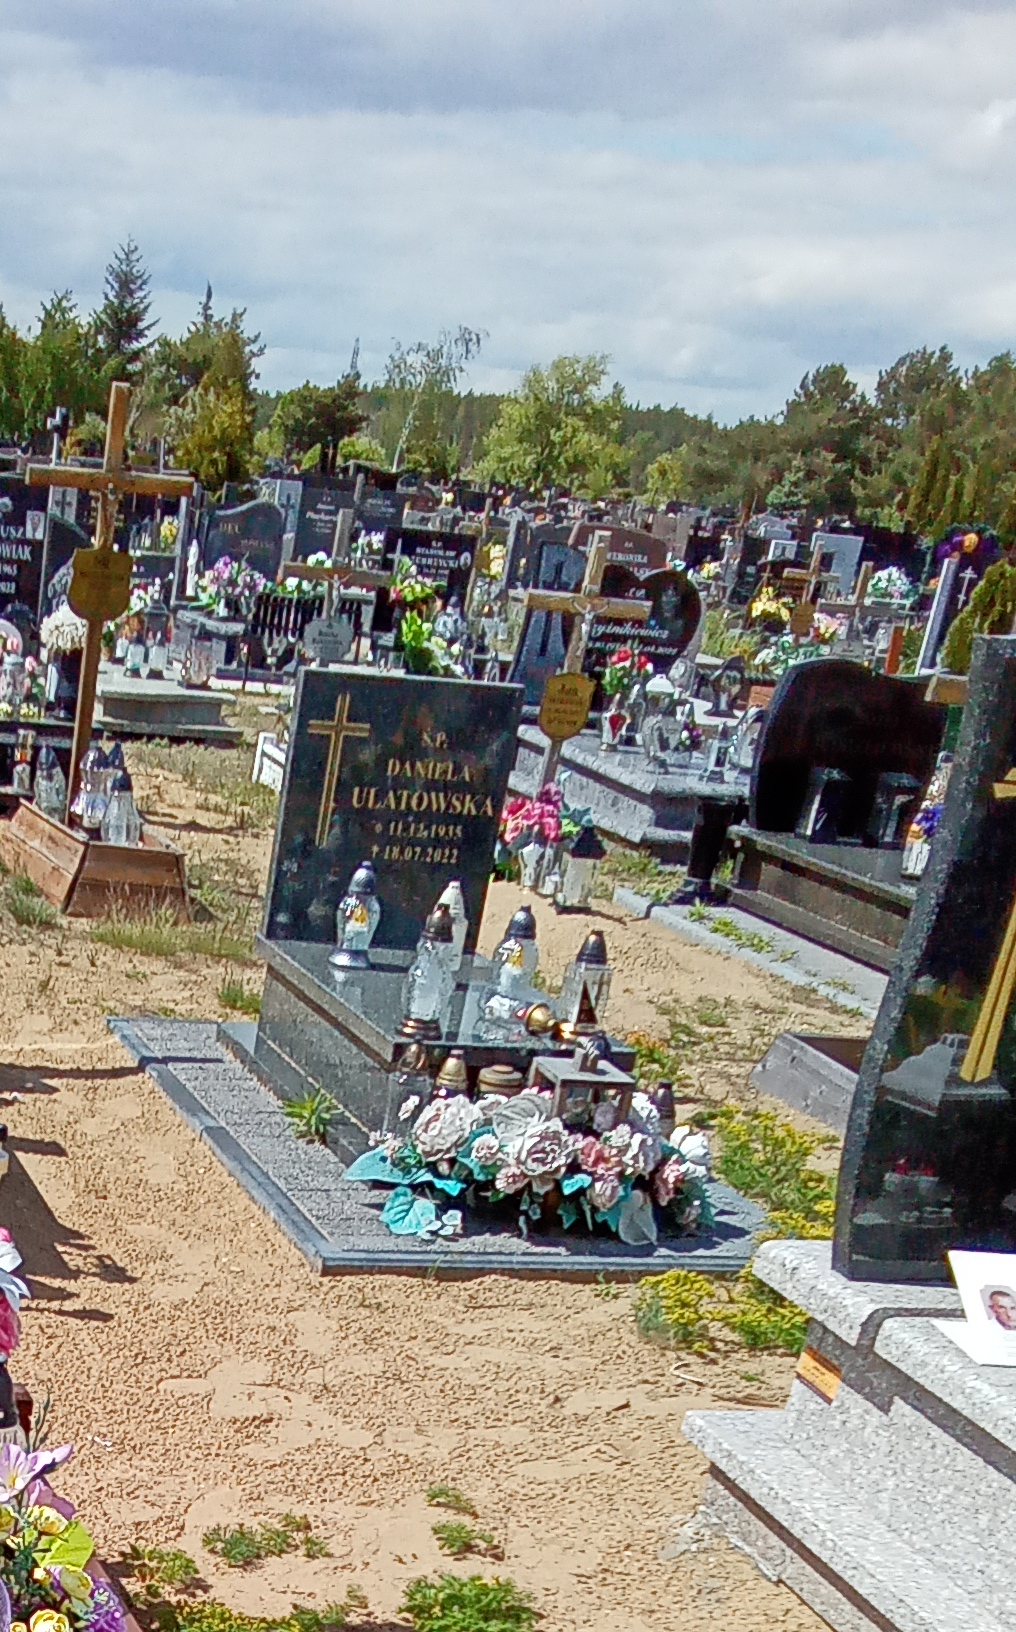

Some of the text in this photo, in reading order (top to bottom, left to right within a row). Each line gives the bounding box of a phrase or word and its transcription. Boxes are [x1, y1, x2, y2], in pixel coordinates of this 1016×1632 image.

[386, 757, 471, 783] DANIELA
[351, 786, 494, 817] ULATOWSKA
[383, 845, 459, 865] 18.07.2022
